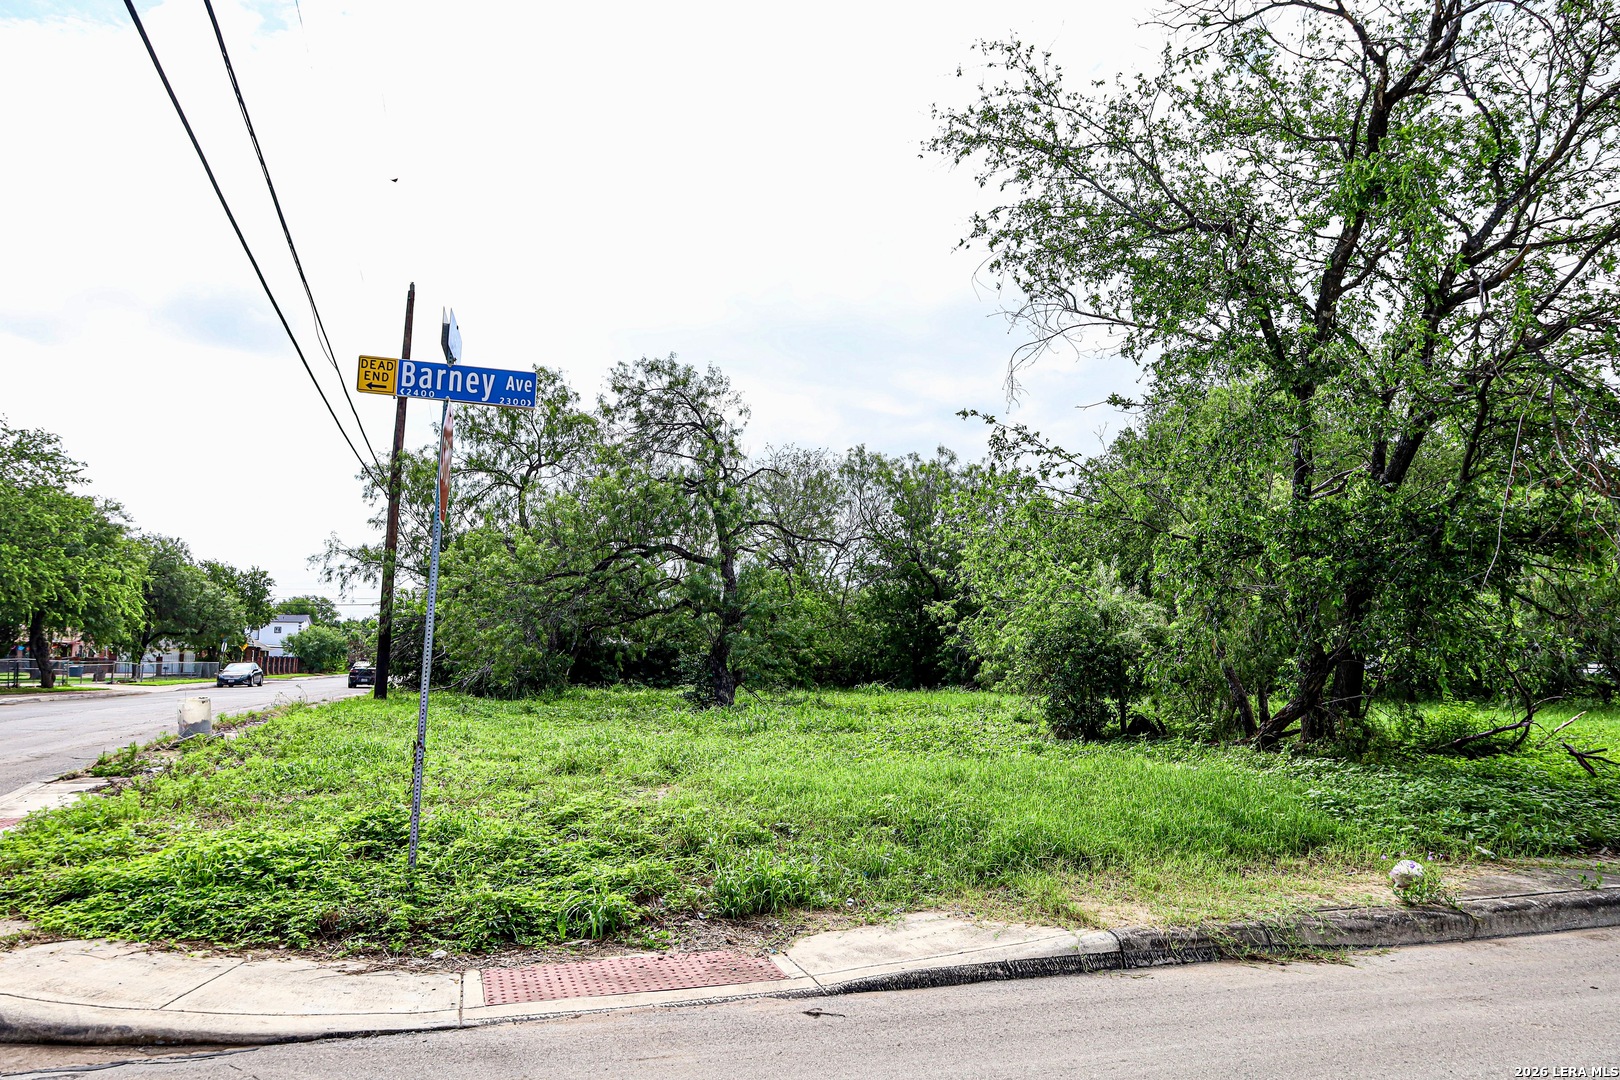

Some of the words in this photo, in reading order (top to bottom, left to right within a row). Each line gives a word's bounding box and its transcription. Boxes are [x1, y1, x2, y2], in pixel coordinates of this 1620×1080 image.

[361, 358, 394, 371] DEAD
[364, 370, 390, 382] END
[401, 361, 496, 402] Barney
[505, 375, 533, 393] Ave
